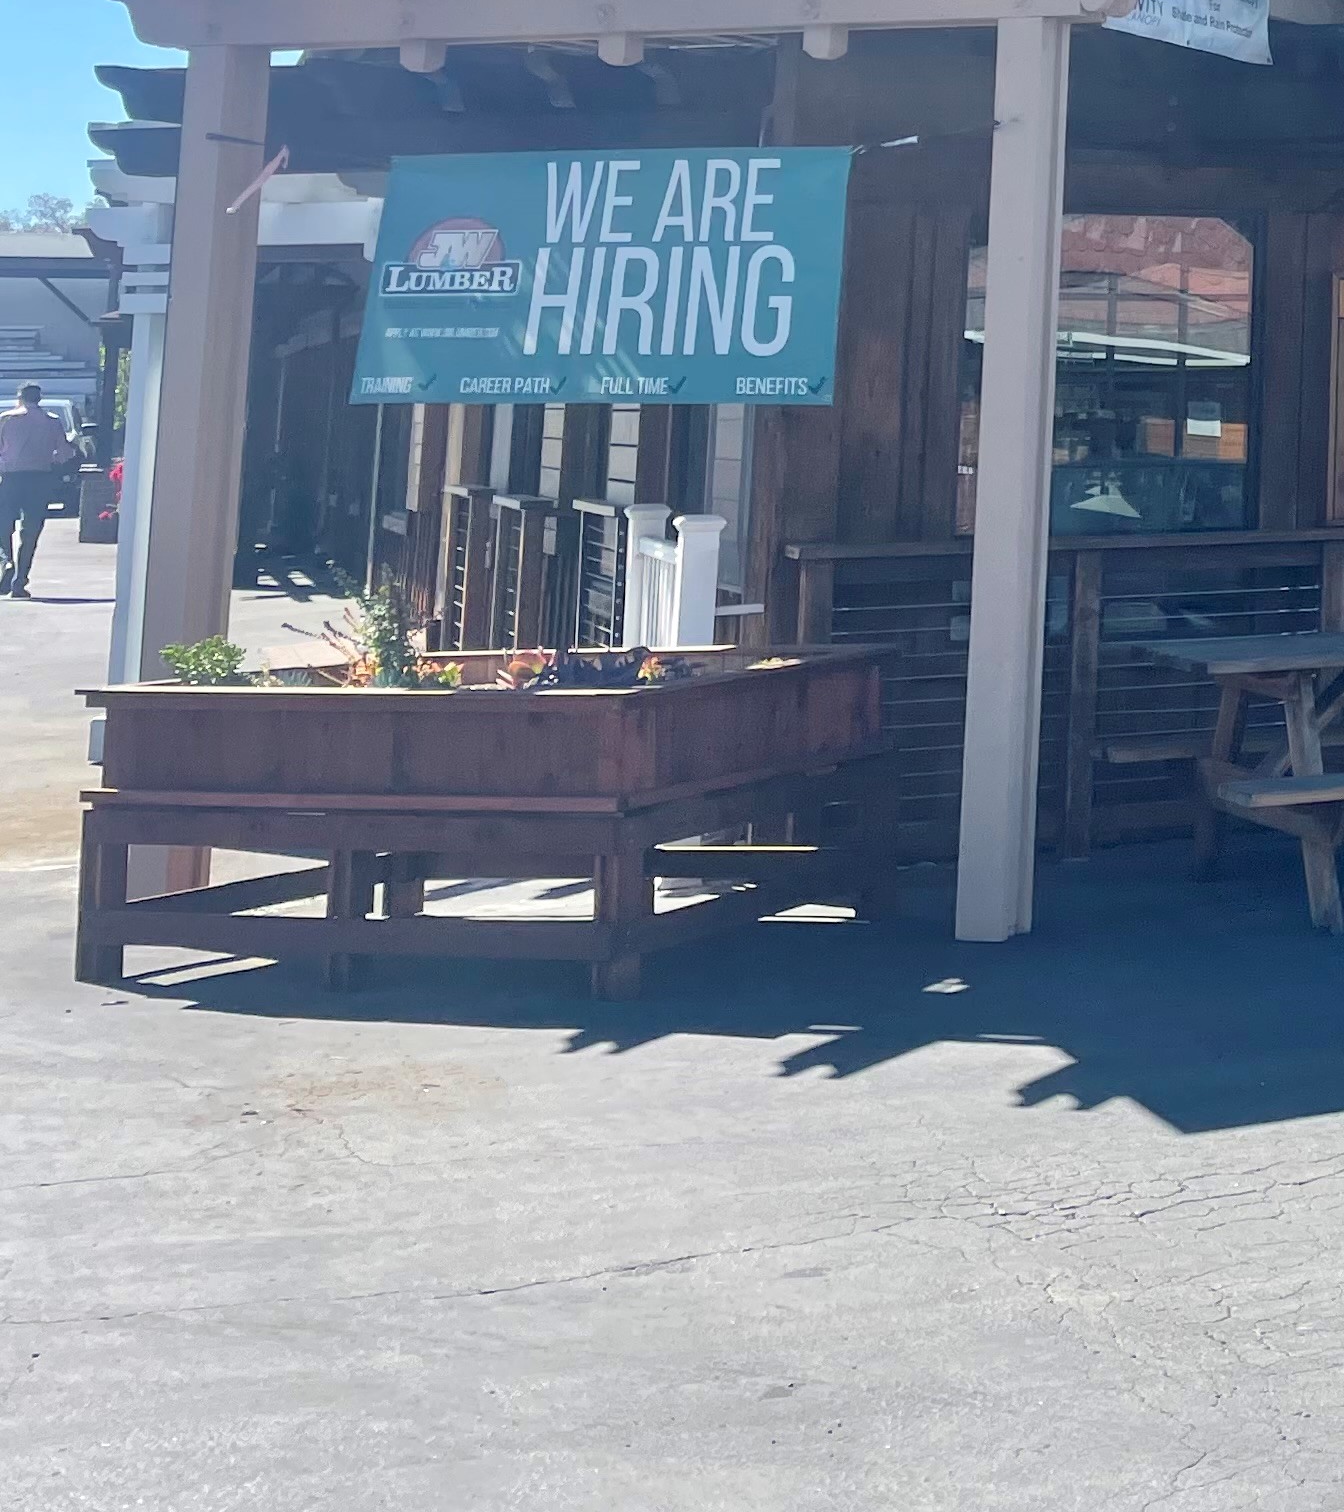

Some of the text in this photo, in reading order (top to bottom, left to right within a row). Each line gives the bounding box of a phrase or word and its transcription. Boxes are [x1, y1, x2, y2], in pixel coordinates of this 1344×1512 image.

[545, 158, 782, 244] WE ARE
[385, 266, 515, 293] LUMBER
[522, 244, 796, 358] HIRING
[360, 376, 414, 394] TRAINING
[459, 377, 551, 395] CAREER PATH
[600, 376, 670, 395] FULL TIME
[735, 377, 809, 395] BENEFITS
